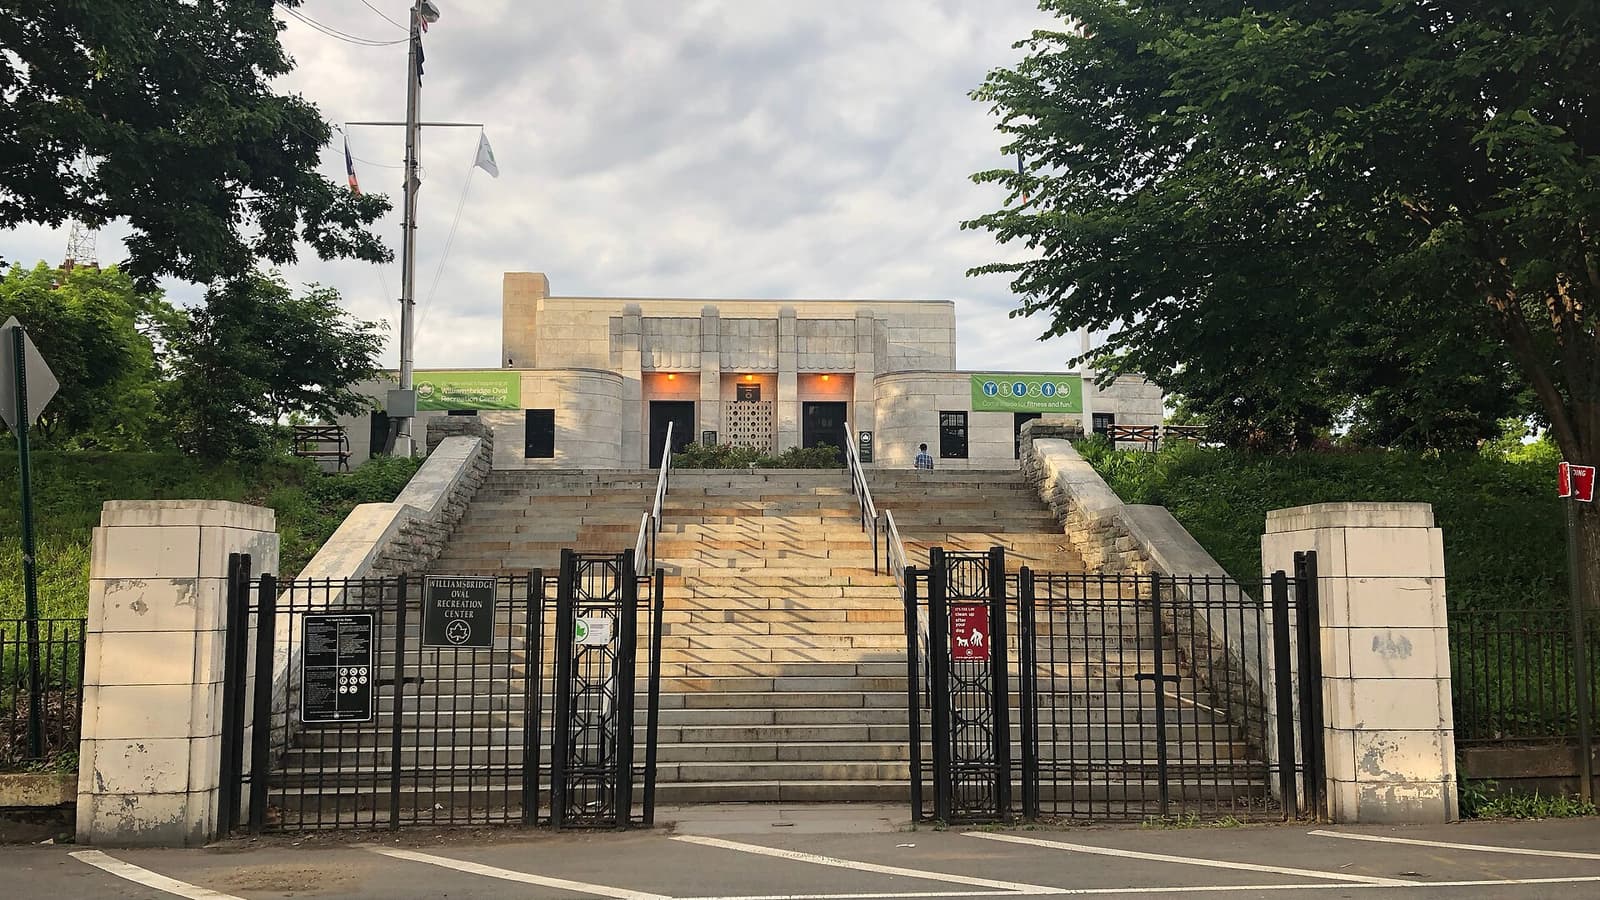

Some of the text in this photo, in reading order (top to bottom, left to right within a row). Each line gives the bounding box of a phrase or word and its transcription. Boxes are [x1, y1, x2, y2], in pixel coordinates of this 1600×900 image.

[430, 580, 493, 589] WILLIAMSBRIDGE
[451, 590, 470, 598] OVAL
[437, 599, 483, 608] RECREATION
[444, 609, 474, 618] CENTER
